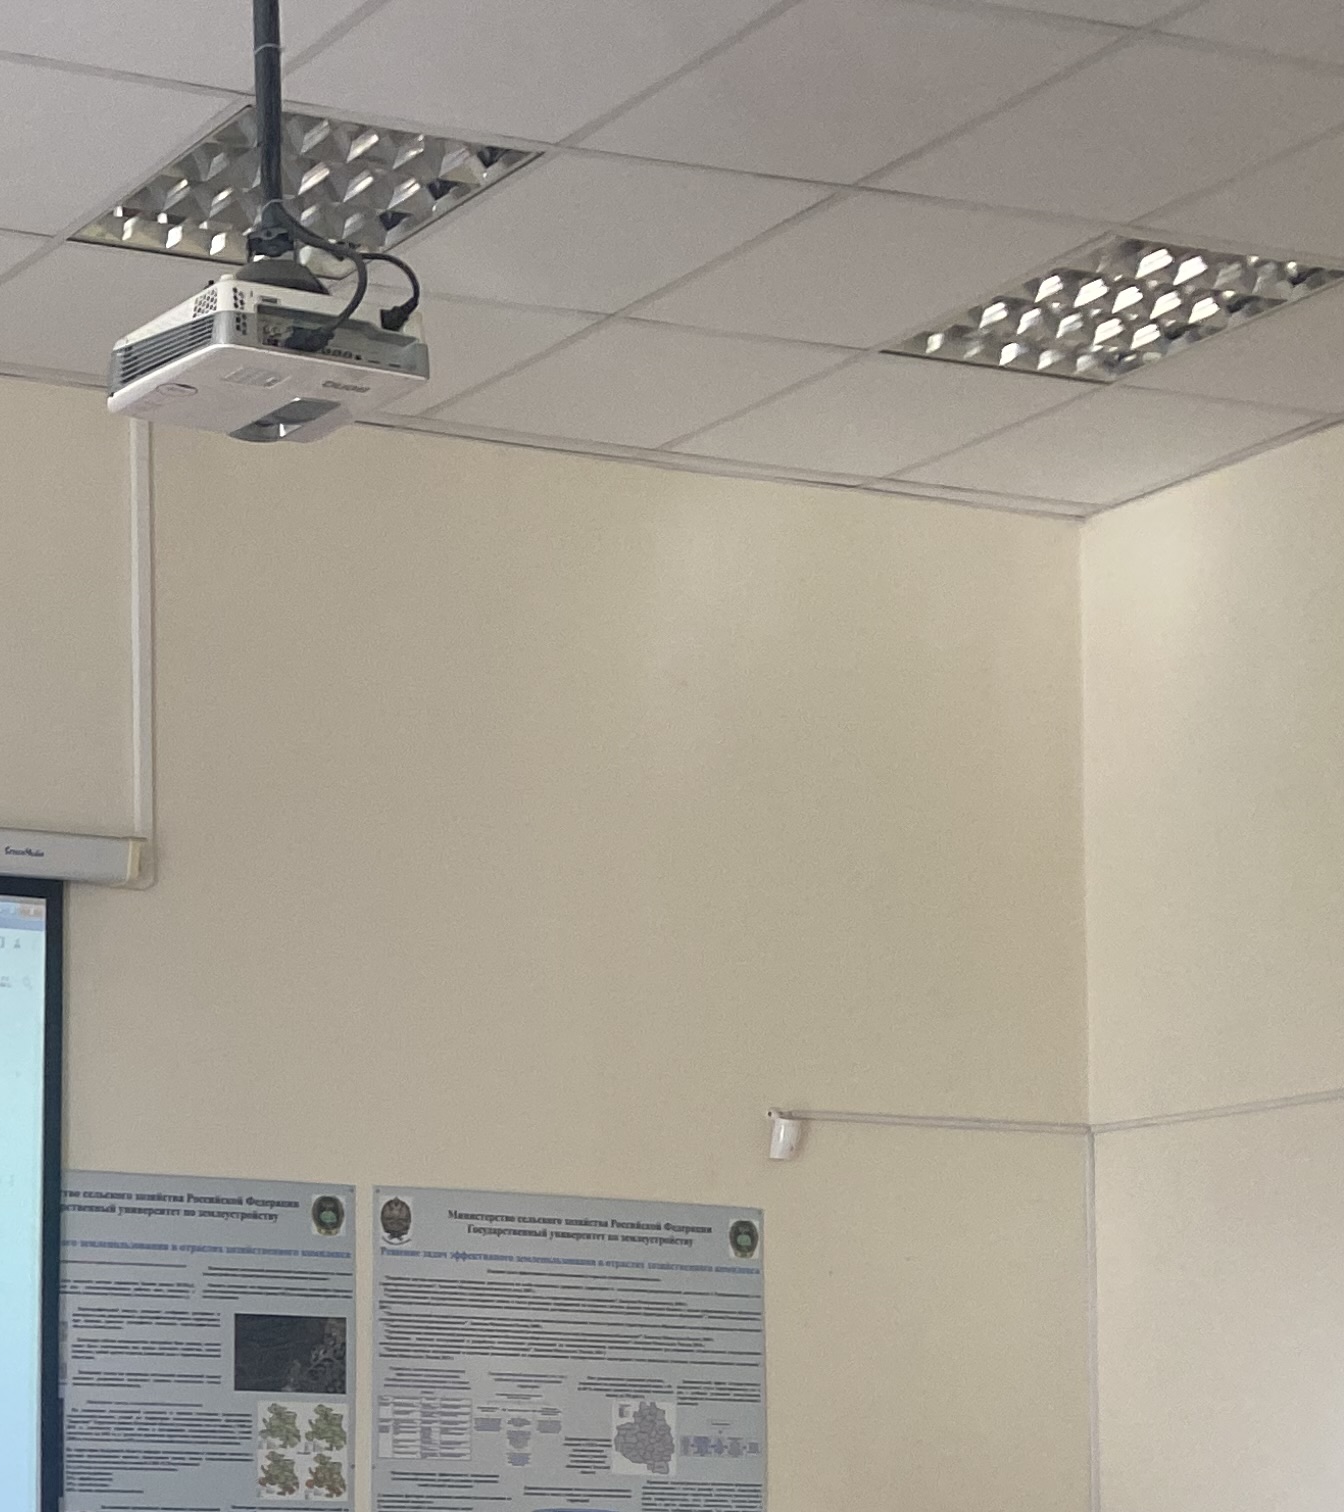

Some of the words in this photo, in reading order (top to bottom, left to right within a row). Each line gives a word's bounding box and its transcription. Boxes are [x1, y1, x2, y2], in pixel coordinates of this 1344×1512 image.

[187, 1193, 243, 1206] Российской
[448, 1210, 515, 1223] Министерство
[610, 1219, 662, 1231] Российской
[467, 1224, 547, 1238] Государственный
